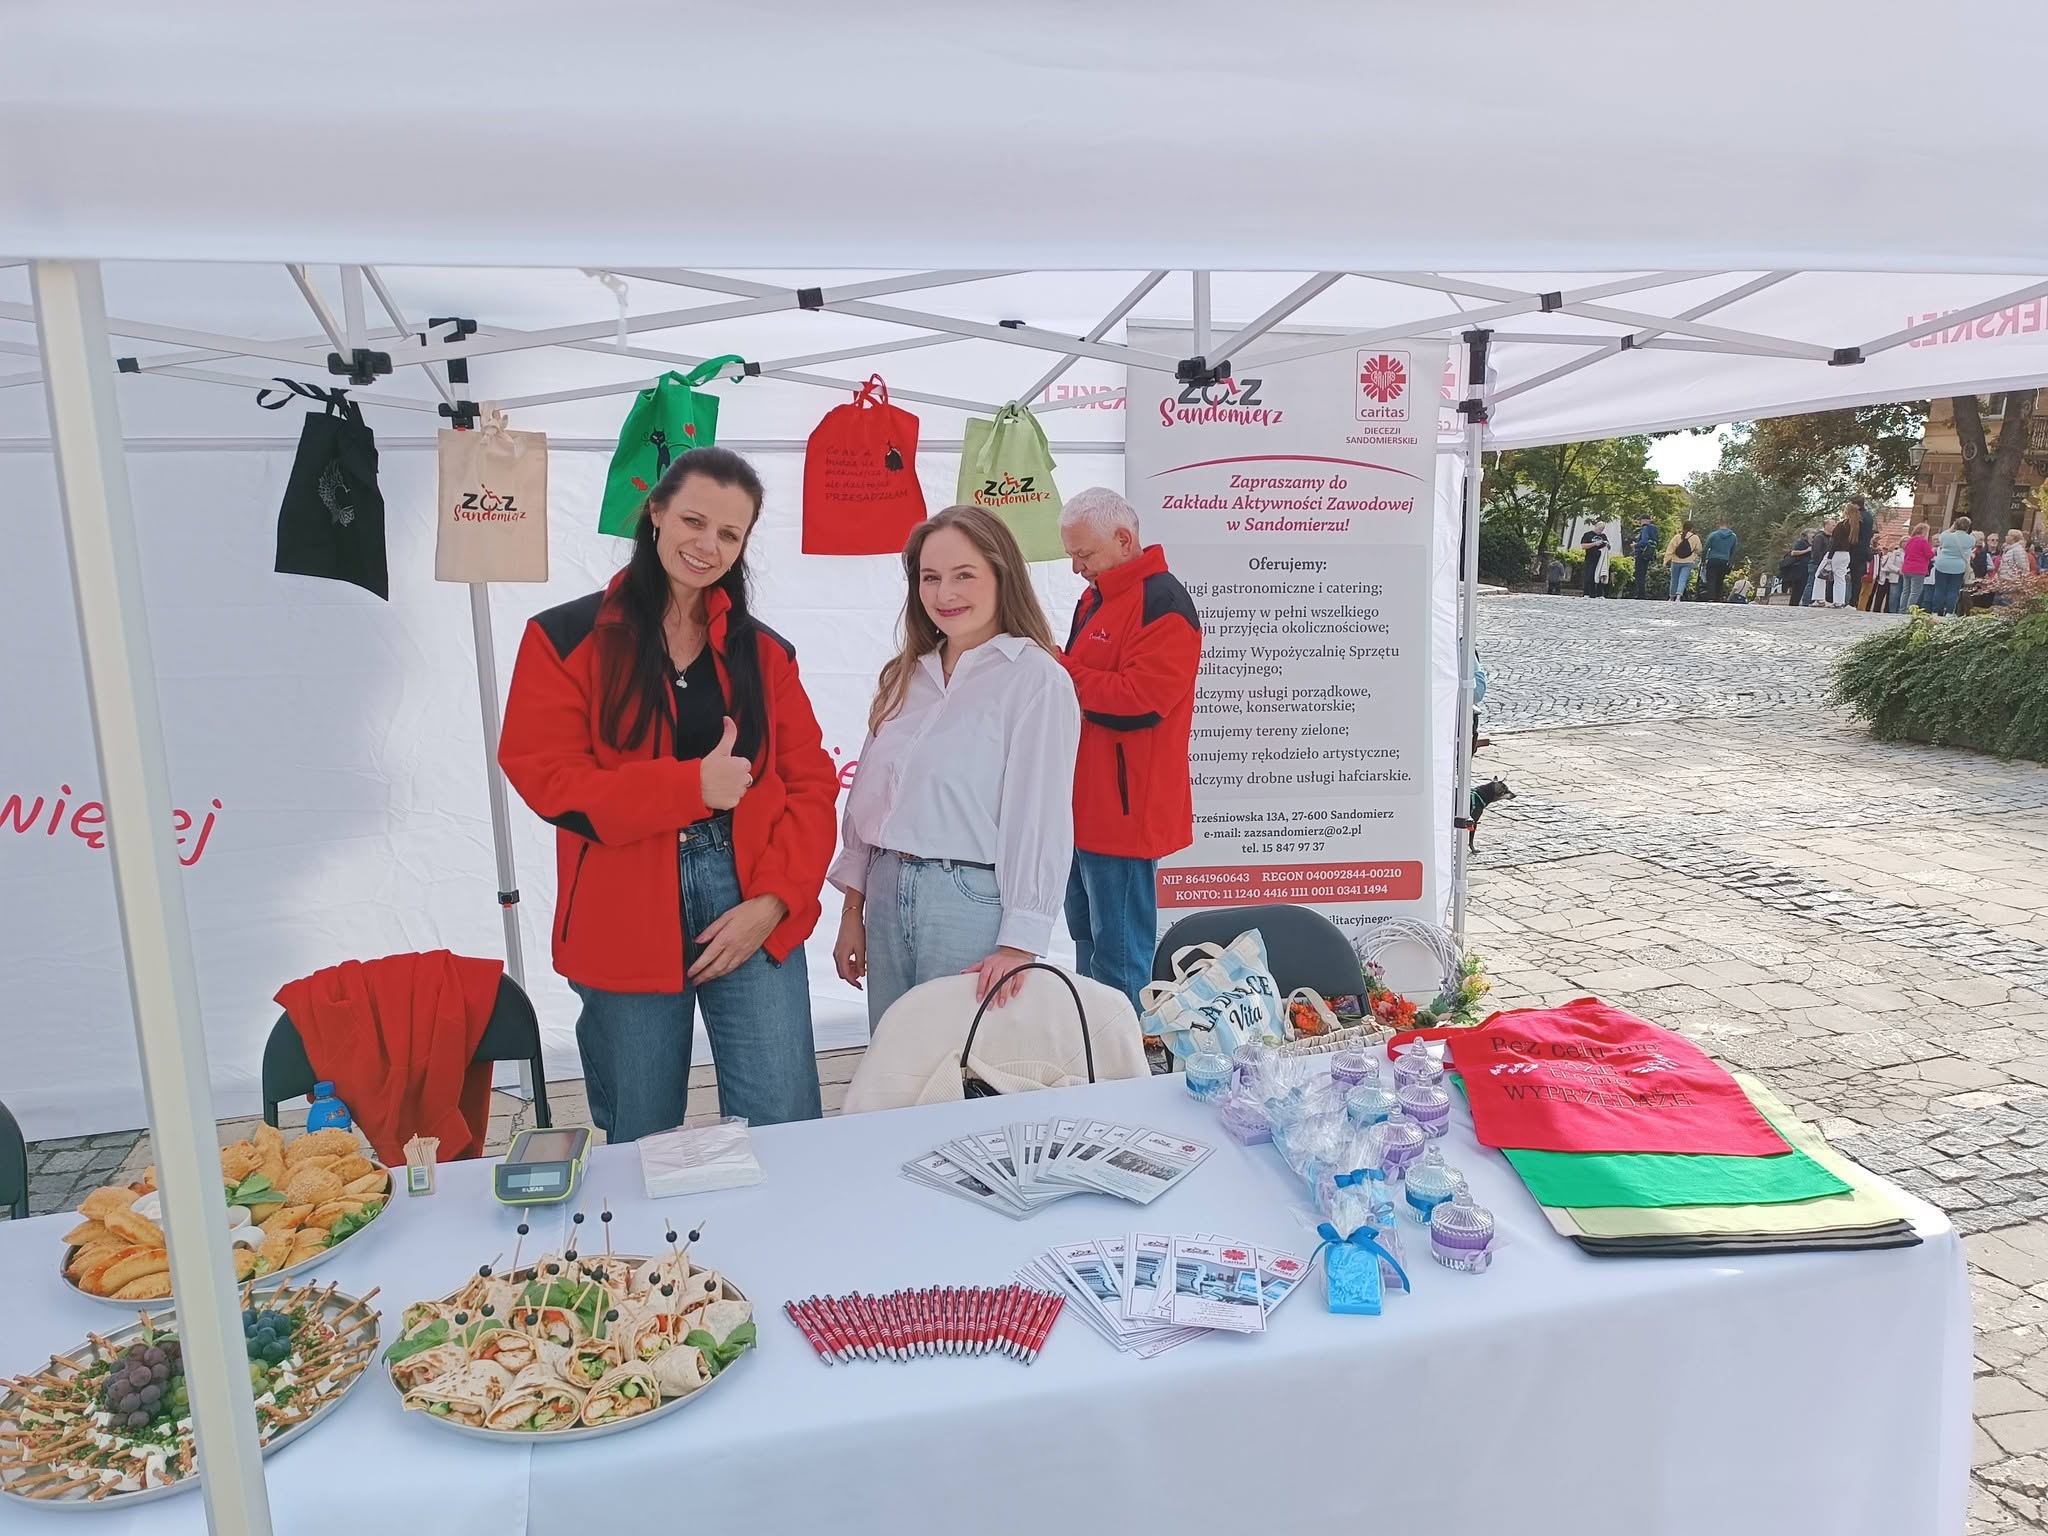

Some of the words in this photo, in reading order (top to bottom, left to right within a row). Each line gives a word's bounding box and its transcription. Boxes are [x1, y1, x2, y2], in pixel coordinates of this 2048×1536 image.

[1159, 395, 1283, 427] Sandomierz
[1360, 406, 1405, 418] caritas
[1364, 427, 1401, 435] DIECEZJI
[1345, 436, 1418, 445] SANDOMIERSKIEJ
[1229, 474, 1325, 492] Zapraszamy
[1328, 475, 1348, 490] do
[974, 489, 1051, 507] Sandomierz
[1162, 494, 1229, 511] Zakładu
[1232, 494, 1323, 513] Aktywności
[1326, 496, 1414, 514] Zawodowej
[1226, 520, 1241, 531] w
[1244, 517, 1350, 532] Sandomierzu!
[1248, 557, 1328, 573] Oferujemy:
[1211, 582, 1315, 598] gastronomiczne
[1318, 582, 1323, 594] i
[1326, 582, 1383, 597] catering;
[1259, 609, 1271, 618] w
[1274, 605, 1308, 621] pełni
[1311, 605, 1380, 620] wszelkiego
[1201, 622, 1216, 637] ju
[1219, 622, 1278, 637] przyjęcia
[1281, 621, 1390, 635] okolicznościowe;
[1200, 646, 1247, 661] adzimy
[1250, 645, 1346, 660] Wypożyczalnię
[1349, 645, 1400, 659] Sprzętu
[1195, 686, 1244, 702] dczymy
[1248, 686, 1289, 701] usługi
[1291, 685, 1371, 701] porządkowe,
[1192, 702, 1243, 715] ontowe,
[1246, 699, 1356, 714] konserwatorskie;
[1256, 727, 1298, 740] tereny
[1301, 723, 1350, 737] zielone;
[1251, 747, 1319, 763] rękodzieło
[1322, 748, 1400, 761] artystyczne;
[1246, 771, 1293, 785] drobne
[1296, 770, 1335, 784] usługi
[1338, 769, 1412, 783] hafciarskie.
[1191, 811, 1264, 824] Trześniowska
[1266, 811, 1289, 823] 13A,
[1291, 810, 1328, 821] 27-600
[1330, 808, 1395, 820] Sandomierz
[0, 784, 223, 866] więej
[1203, 828, 1242, 839] e-mail:
[1244, 825, 1362, 839] zazsandomierz@o2.pl
[1241, 843, 1259, 854] tel.
[1262, 843, 1273, 853] 15
[1276, 843, 1296, 853] 847
[1298, 842, 1312, 852] 97
[1312, 841, 1326, 852] 37
[1162, 875, 1183, 885] NIP
[1185, 873, 1250, 884] 8641960643
[1262, 871, 1304, 882] REGON
[1306, 868, 1402, 881] 040092844-00210
[1175, 889, 1221, 901] KONTO:
[1223, 889, 1232, 899] 11
[1235, 888, 1261, 899] 1240
[1263, 887, 1288, 898] 4416
[1290, 887, 1309, 897] 1111
[1311, 886, 1335, 897] 0011
[1337, 885, 1361, 895] 0341
[1363, 884, 1389, 894] 1494
[1190, 1005, 1223, 1033] LA
[1229, 1003, 1263, 1032] Vita
[1489, 1036, 1541, 1055] Bez
[1551, 1039, 1605, 1059] celu
[1503, 1084, 1694, 1108] WYPRZEDAŻE
